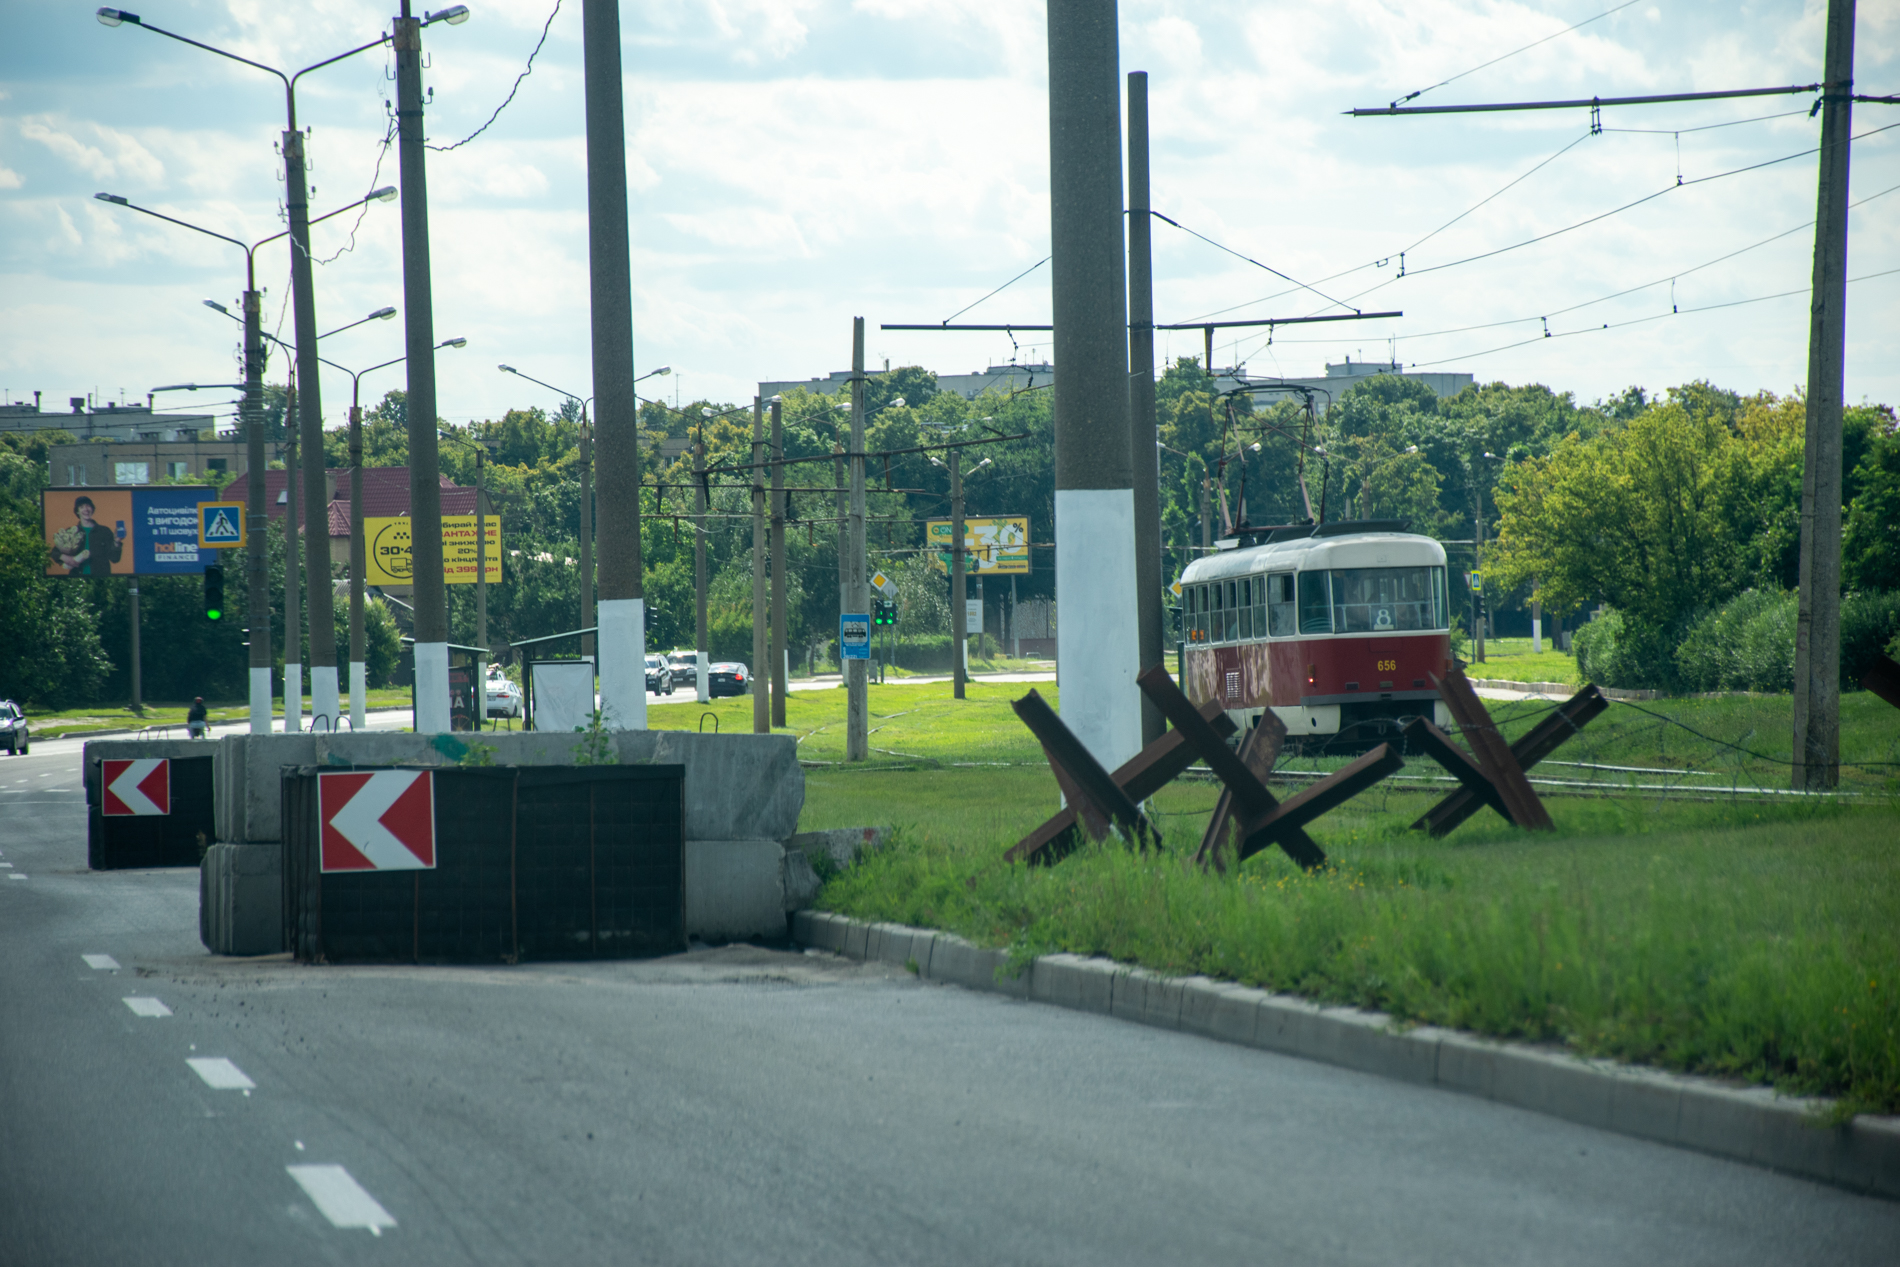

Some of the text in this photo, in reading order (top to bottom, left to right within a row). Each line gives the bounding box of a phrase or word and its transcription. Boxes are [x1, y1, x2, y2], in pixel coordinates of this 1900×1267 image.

[147, 506, 199, 515] Автоцивілк
[154, 542, 198, 552] hotline
[1376, 609, 1391, 626] 8
[1377, 660, 1396, 671] 656
